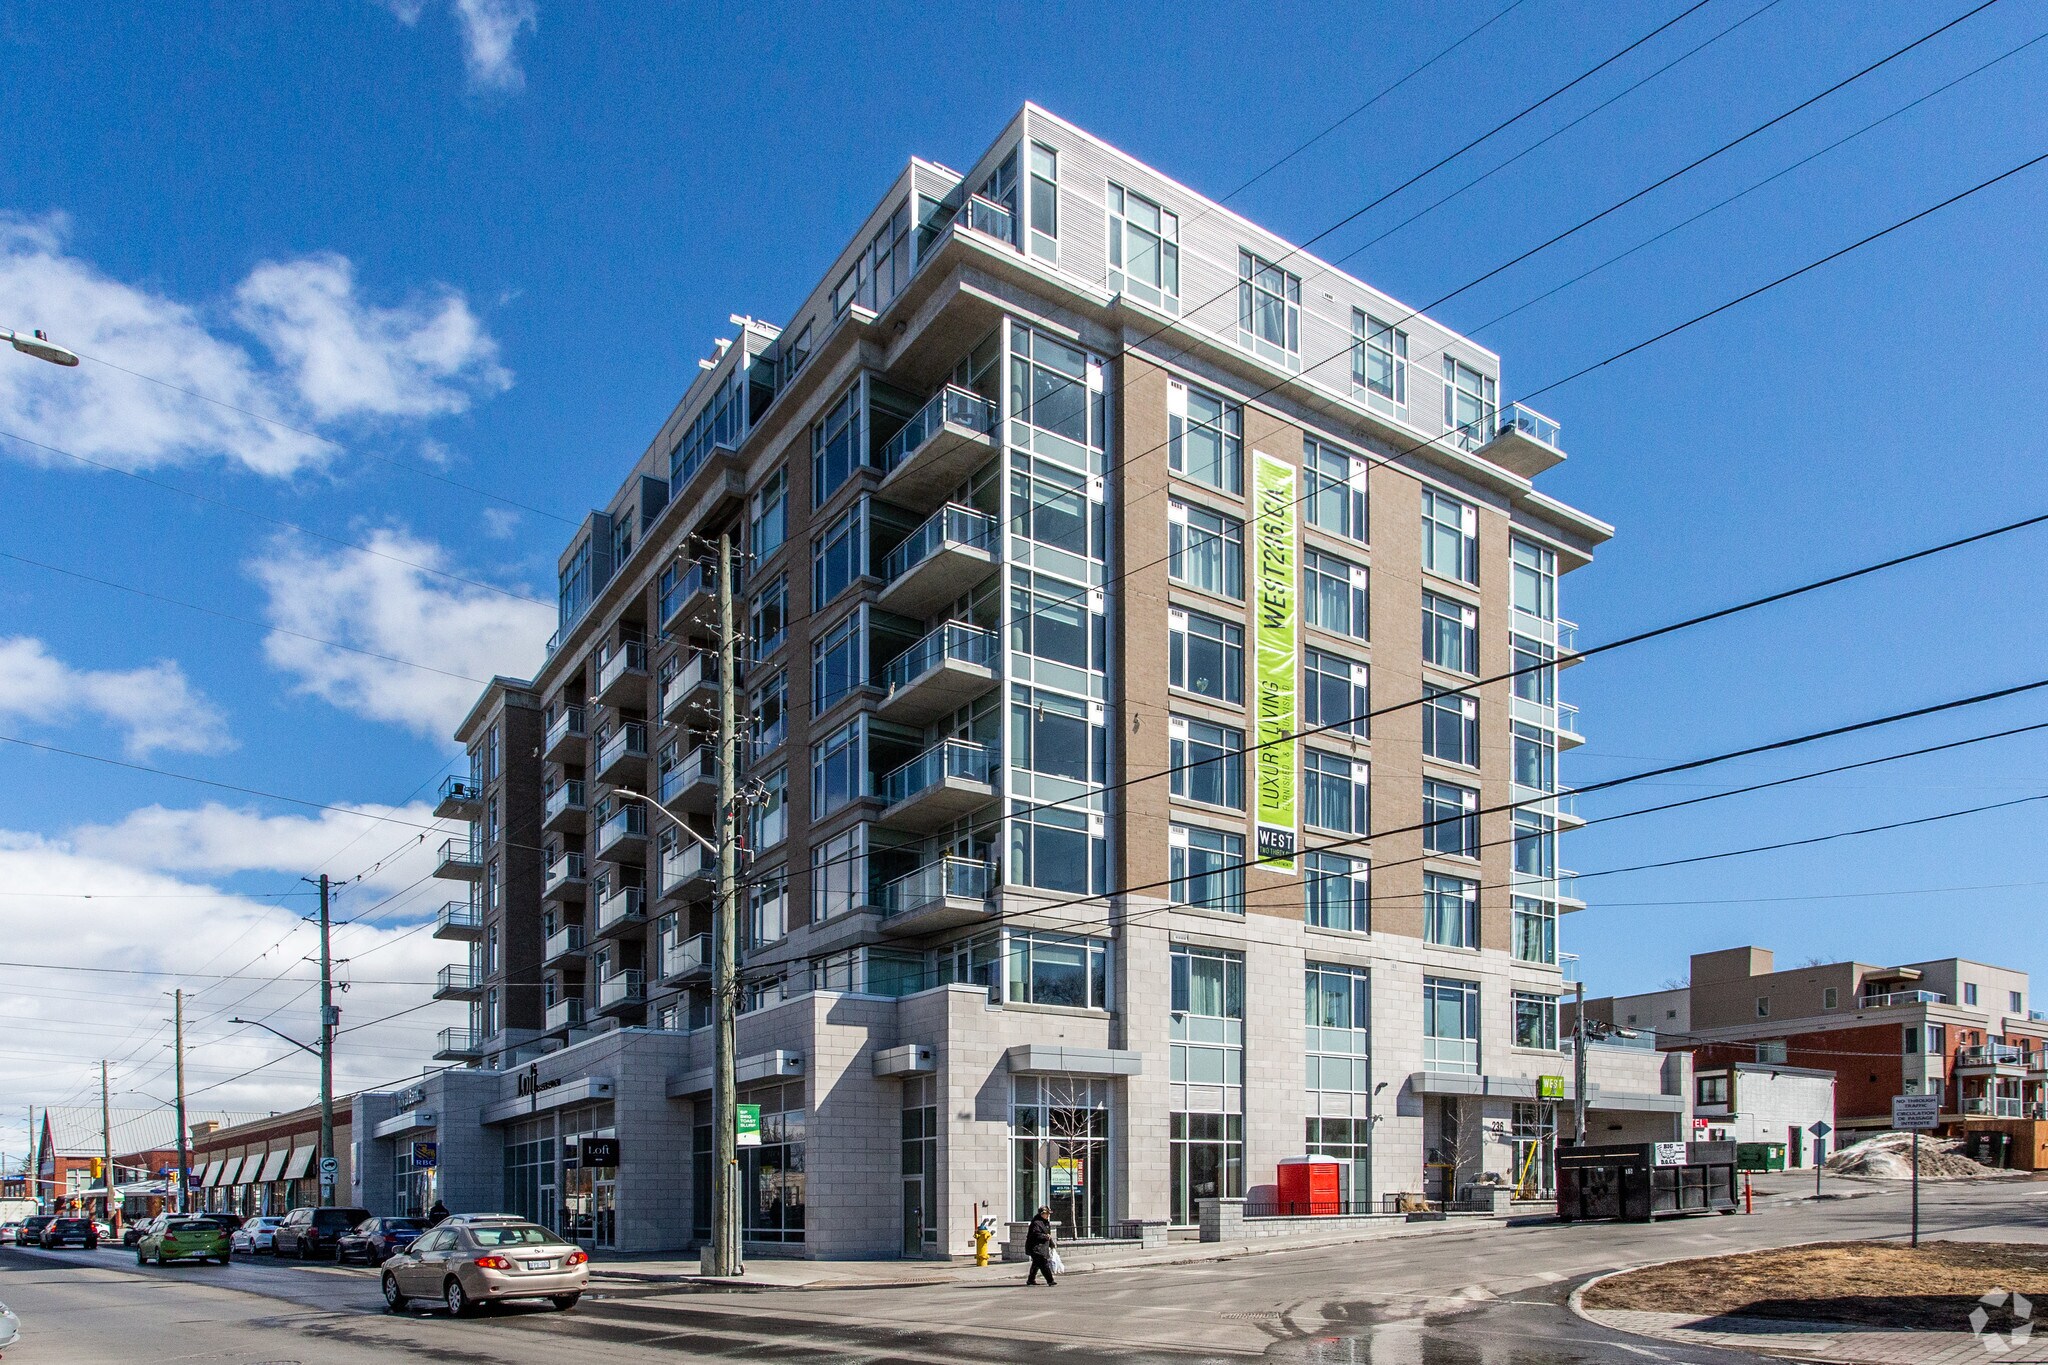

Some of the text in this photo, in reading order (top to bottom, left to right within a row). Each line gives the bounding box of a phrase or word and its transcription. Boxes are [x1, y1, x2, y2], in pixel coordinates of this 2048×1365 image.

[1263, 489, 1286, 629] WEST236.CA
[1262, 680, 1279, 810] LUXURY LIVING
[1282, 764, 1290, 812] FURNISHED
[1259, 830, 1293, 849] WEST
[1259, 845, 1270, 854] TWO
[1542, 1078, 1562, 1089] WEST
[1491, 1121, 1504, 1132] 236
[588, 1144, 610, 1155] Loft
